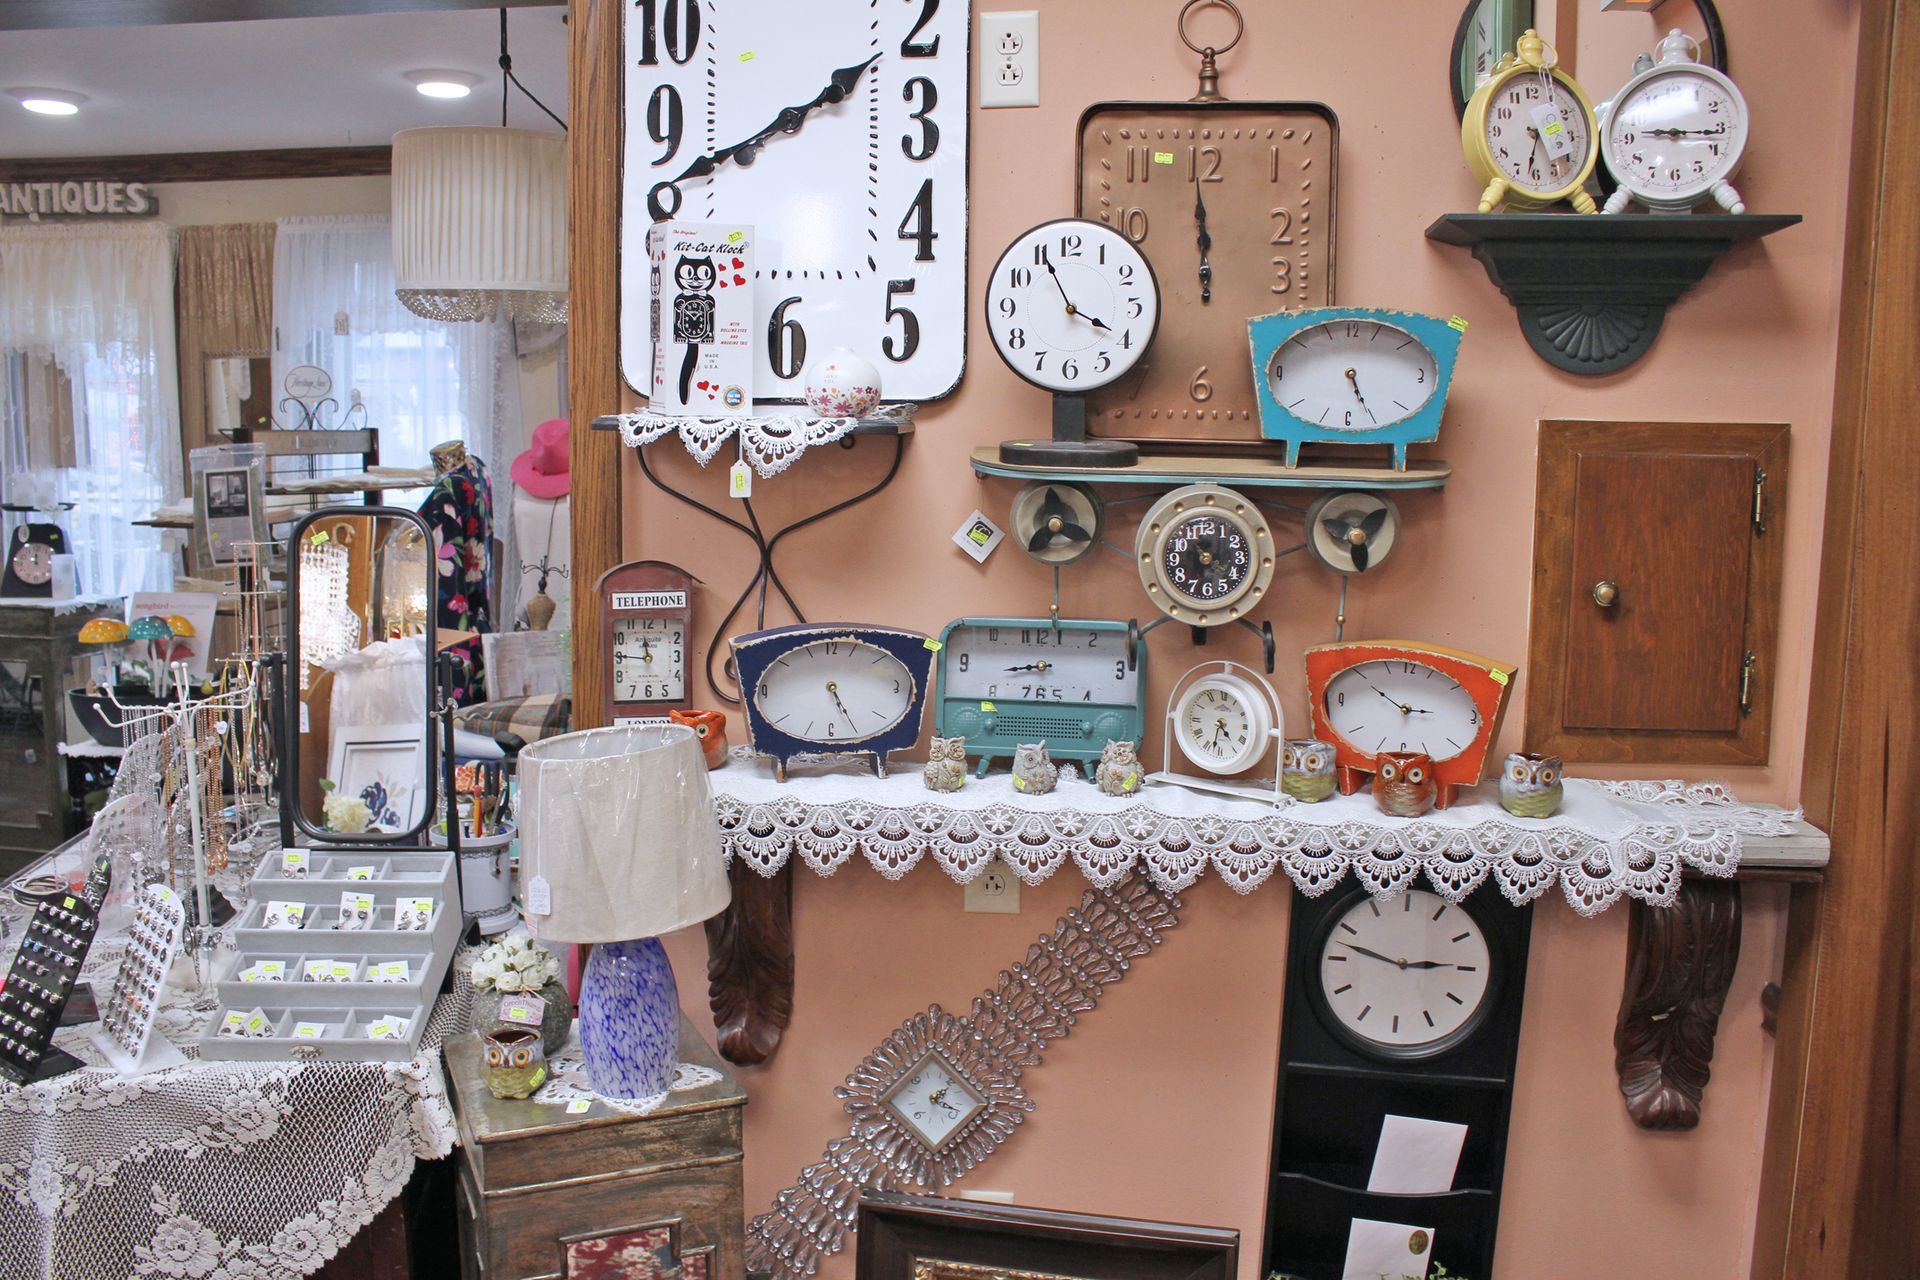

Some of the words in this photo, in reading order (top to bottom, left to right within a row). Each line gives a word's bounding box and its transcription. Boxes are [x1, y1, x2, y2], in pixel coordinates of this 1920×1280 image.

[635, 0, 701, 65] 10
[901, 0, 940, 57] 2
[1510, 92, 1520, 104] 11
[1525, 87, 1539, 100] 12
[1497, 107, 1512, 121] 10
[1708, 101, 1719, 114] 2
[902, 76, 940, 160] 3
[1560, 109, 1569, 121] 2
[647, 84, 683, 166] 9
[1492, 125, 1501, 138] 9
[1715, 122, 1725, 135] 3
[1567, 130, 1575, 142] 3
[1624, 133, 1635, 145] 9
[1126, 145, 1149, 183] 11
[1187, 146, 1223, 183] 12
[1270, 145, 1278, 183] 1
[1513, 163, 1523, 175] 7
[1550, 164, 1558, 177] 5
[1693, 161, 1703, 173] 5
[1532, 169, 1541, 182] 6
[1648, 166, 1656, 179] 7
[1670, 168, 1680, 181] 6
[0, 181, 146, 214] ANTIQUES
[898, 177, 939, 260] 4
[1116, 207, 1148, 243] 10
[1270, 207, 1294, 246] 2
[674, 241, 715, 253] Kit-Cat
[1061, 235, 1082, 257] 12
[1034, 244, 1048, 265] 11
[1099, 243, 1105, 265] 1
[1010, 267, 1031, 288] 10
[1119, 264, 1133, 286] 2
[1271, 257, 1292, 294] 3
[1000, 298, 1016, 319] 9
[1127, 297, 1143, 319] 3
[882, 277, 920, 363] 5
[1346, 323, 1359, 337] 12
[768, 296, 806, 379] 6
[1009, 328, 1025, 349] 8
[1116, 328, 1133, 349] 4
[1034, 351, 1048, 371] 7
[1094, 351, 1111, 373] 5
[1062, 358, 1078, 380] 6
[1276, 365, 1283, 381] 9
[1417, 368, 1424, 383] 3
[1189, 366, 1213, 401] 6
[1344, 411, 1352, 426] 6
[1186, 526, 1198, 540] 11
[1199, 521, 1215, 535] 12
[1219, 524, 1226, 538] 1
[1174, 538, 1188, 552] 10
[1229, 535, 1241, 549] 2
[1169, 553, 1180, 566] 9
[1235, 551, 1245, 565] 3
[1175, 568, 1186, 582] 8
[1229, 566, 1239, 580] 4
[1188, 579, 1198, 593] 7
[1202, 583, 1213, 596] 6
[1218, 579, 1228, 592] 5
[616, 595, 683, 608] TELEPHONE
[627, 619, 635, 629] 11
[643, 619, 654, 629] 12
[614, 632, 625, 646] 10
[673, 632, 681, 645] 2
[989, 628, 998, 642] 10
[1021, 630, 1031, 643] 11
[1036, 630, 1050, 645] 12
[1057, 630, 1062, 645] 1
[1088, 632, 1098, 647] 2
[826, 642, 838, 655] 12
[615, 651, 623, 664] 9
[674, 650, 681, 663] 3
[960, 654, 969, 672] 9
[1115, 660, 1125, 680] 3
[1403, 662, 1417, 674] 12
[616, 670, 623, 684] 8
[674, 669, 681, 682] 4
[629, 685, 636, 698] 7
[645, 685, 652, 698] 6
[662, 684, 669, 698] 5
[761, 684, 767, 698] 9
[893, 680, 900, 694] 3
[1022, 686, 1031, 699] 7
[1338, 692, 1344, 707] 9
